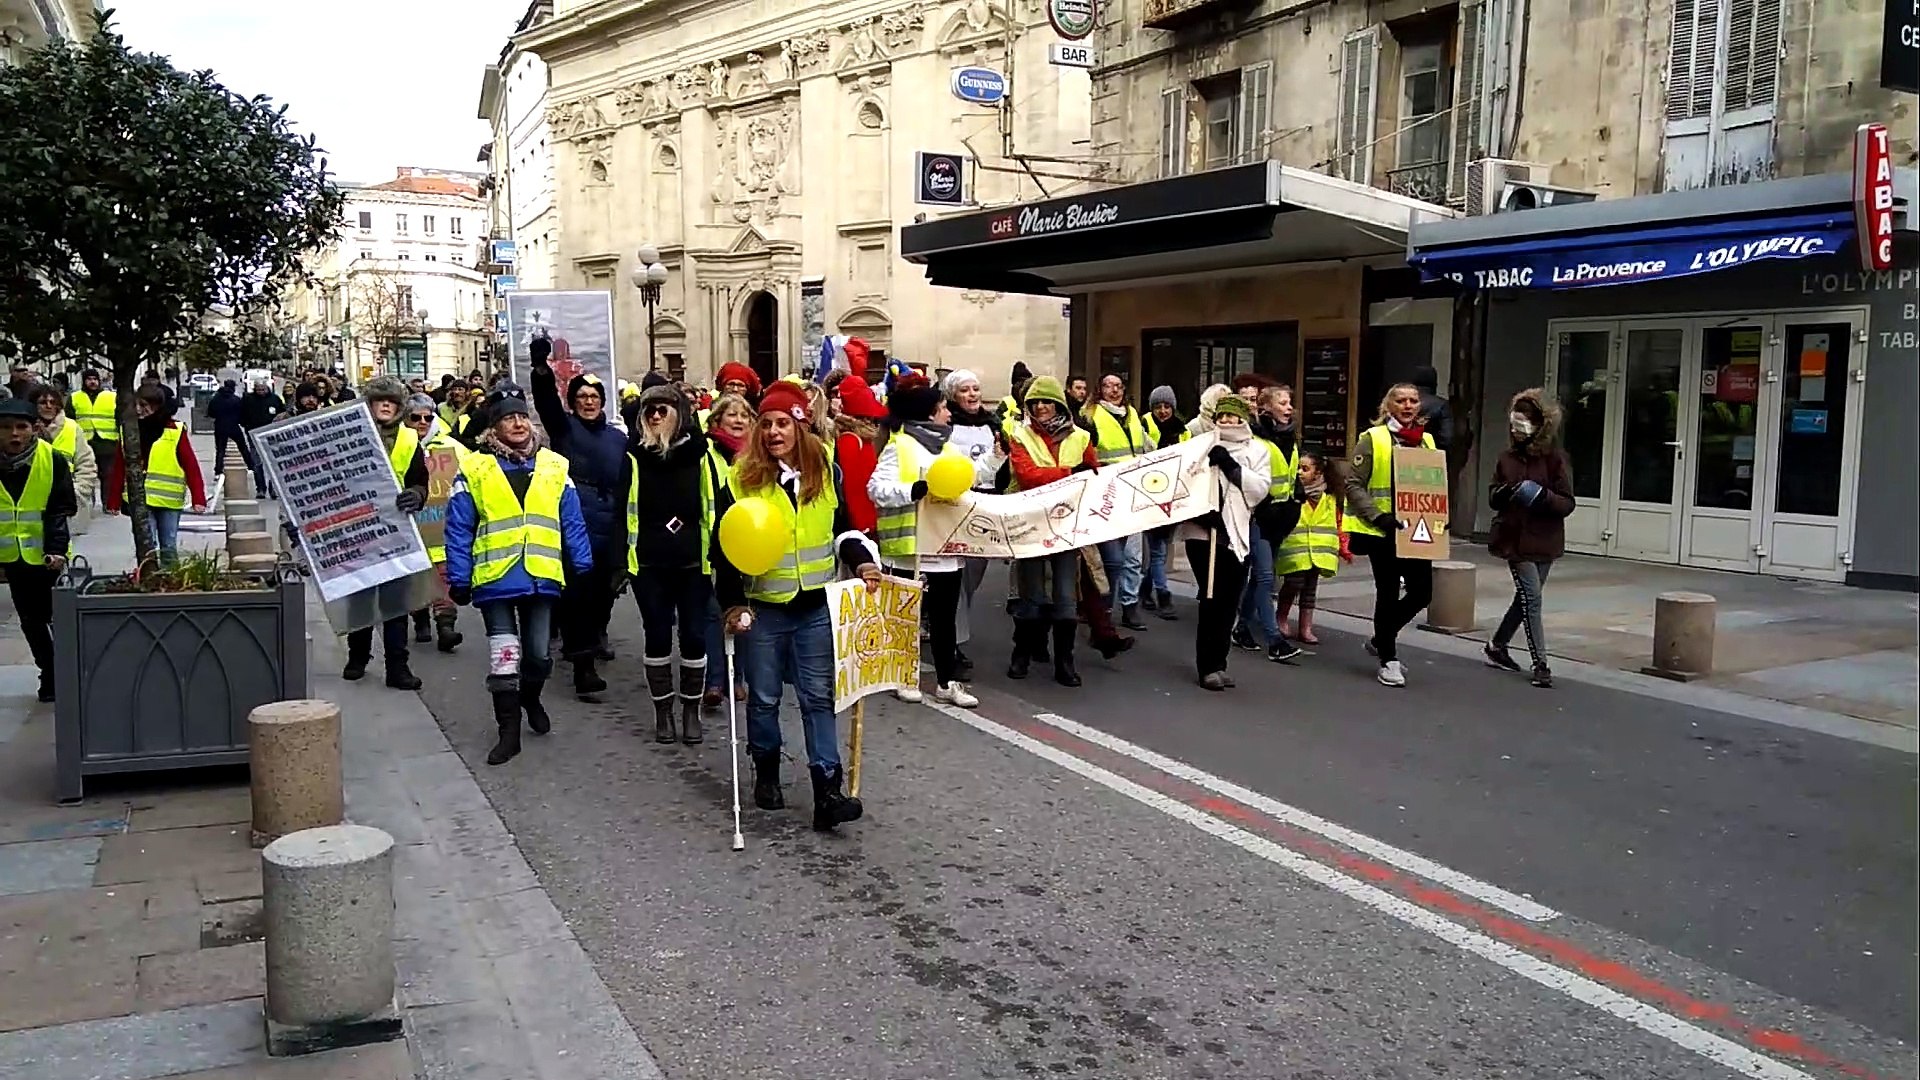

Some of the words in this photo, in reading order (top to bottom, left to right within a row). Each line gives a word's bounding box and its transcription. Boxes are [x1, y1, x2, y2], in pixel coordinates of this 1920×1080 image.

[1062, 47, 1087, 62] BAR
[960, 76, 1003, 91] GUINNESS
[1875, 129, 1893, 263] TABAC
[991, 216, 1013, 234] CAFÉ
[1018, 206, 1064, 235] Marie
[1066, 203, 1119, 228] Blachère
[1474, 267, 1534, 289] TABAC
[1689, 236, 1824, 270] L'OLYMPIC
[1903, 303, 1919, 319] B
[1880, 332, 1919, 348] TAB
[318, 415, 344, 430] celui
